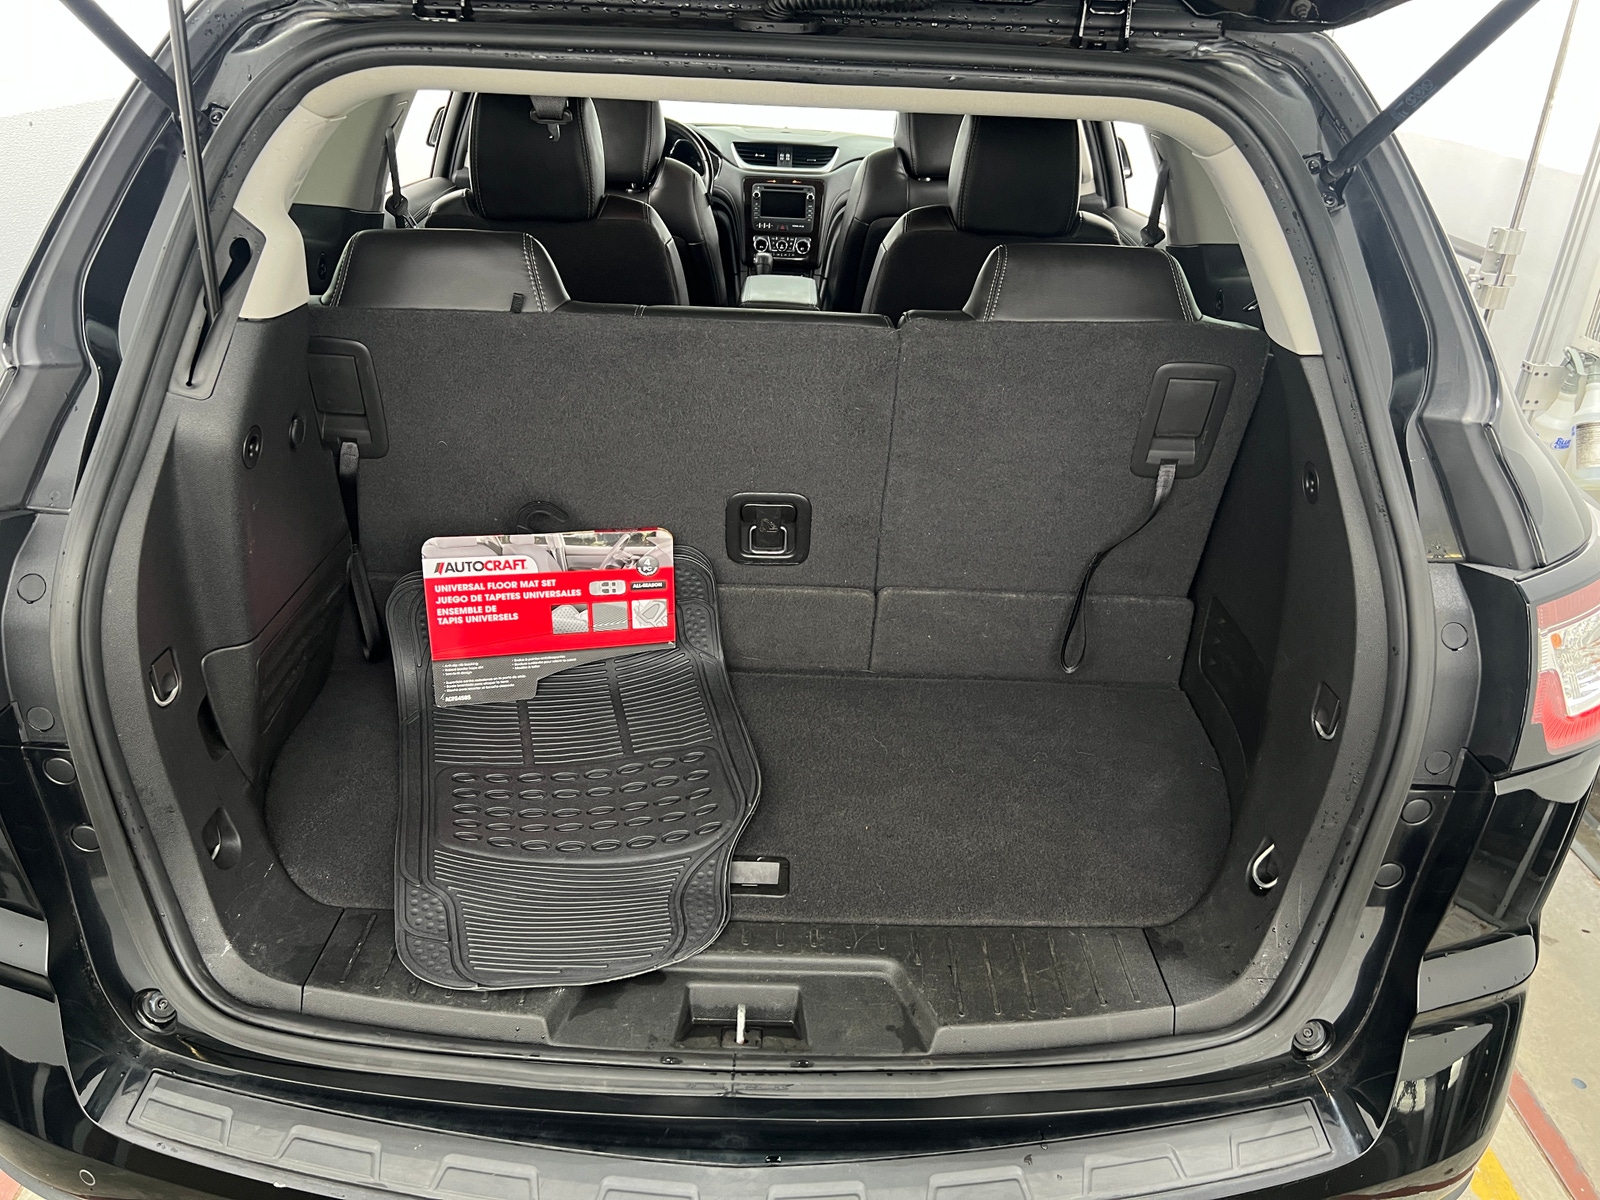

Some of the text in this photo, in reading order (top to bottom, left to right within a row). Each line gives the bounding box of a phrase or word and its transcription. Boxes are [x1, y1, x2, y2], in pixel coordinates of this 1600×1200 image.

[445, 559, 526, 574] AUTOCRAFT
[644, 558, 651, 566] 4
[434, 579, 556, 592] UNIVERSAL FLOOR MAT SET
[435, 589, 582, 604] JUEGO DE TAPETES UNIVERSALES
[436, 606, 482, 615] ENSEMBLE
[437, 613, 518, 626] TAPIS UNIVERSELS
